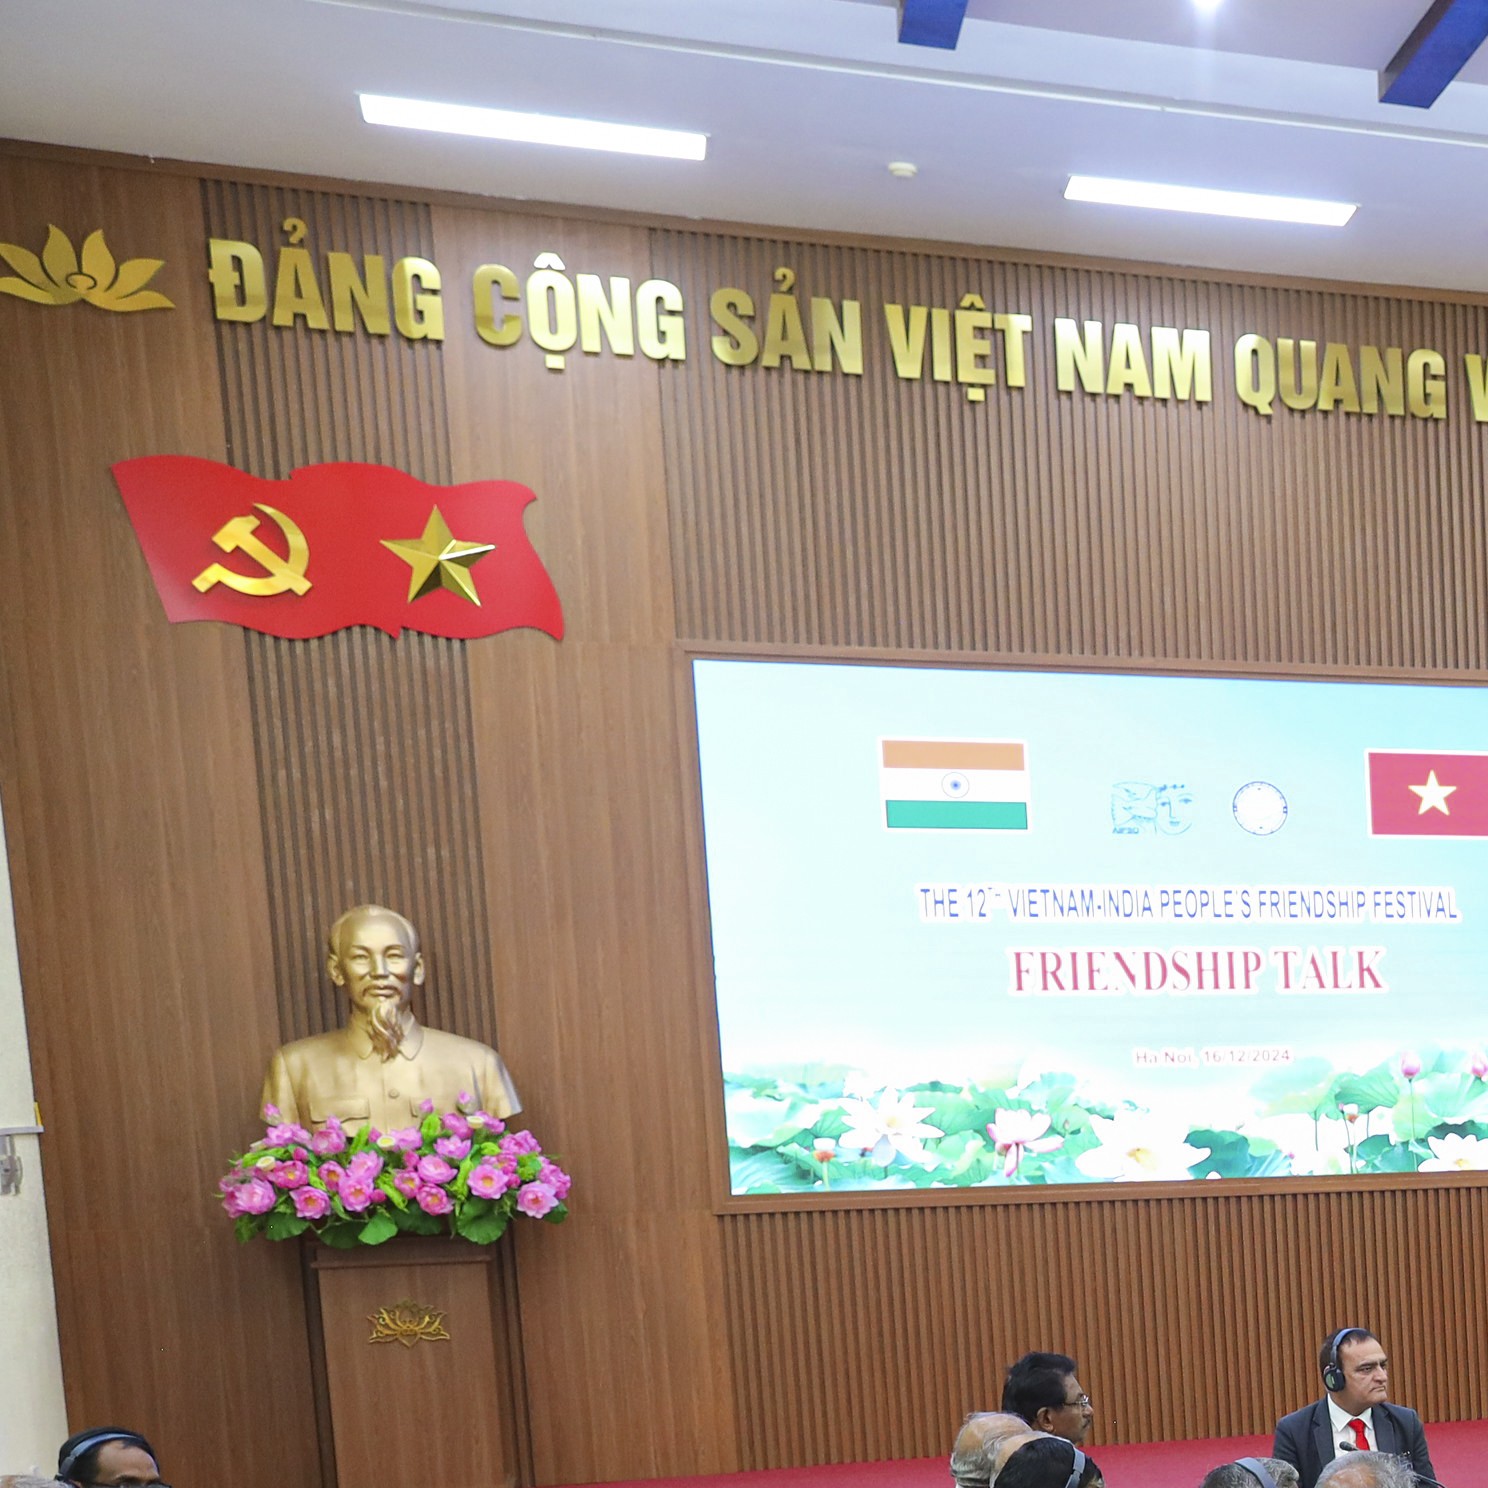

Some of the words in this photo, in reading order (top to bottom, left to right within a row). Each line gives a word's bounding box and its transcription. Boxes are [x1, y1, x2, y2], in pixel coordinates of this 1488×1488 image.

[208, 218, 445, 342] ĐẢNG
[471, 252, 686, 370] CỘNG
[709, 267, 863, 376] SẢN
[884, 293, 1031, 401] VIỆT
[1053, 317, 1212, 404] NAM
[1234, 333, 1447, 420] QUANG
[920, 888, 959, 918] THE
[1008, 888, 1154, 918] VIETNAM-INDIA
[1160, 889, 1252, 918] PEOPLE'S
[1258, 890, 1367, 919] FRIENDSHIP
[1373, 891, 1458, 919] FESTIVAL
[1013, 950, 1262, 992] FRIENDSHIP
[1273, 950, 1384, 990] TALK
